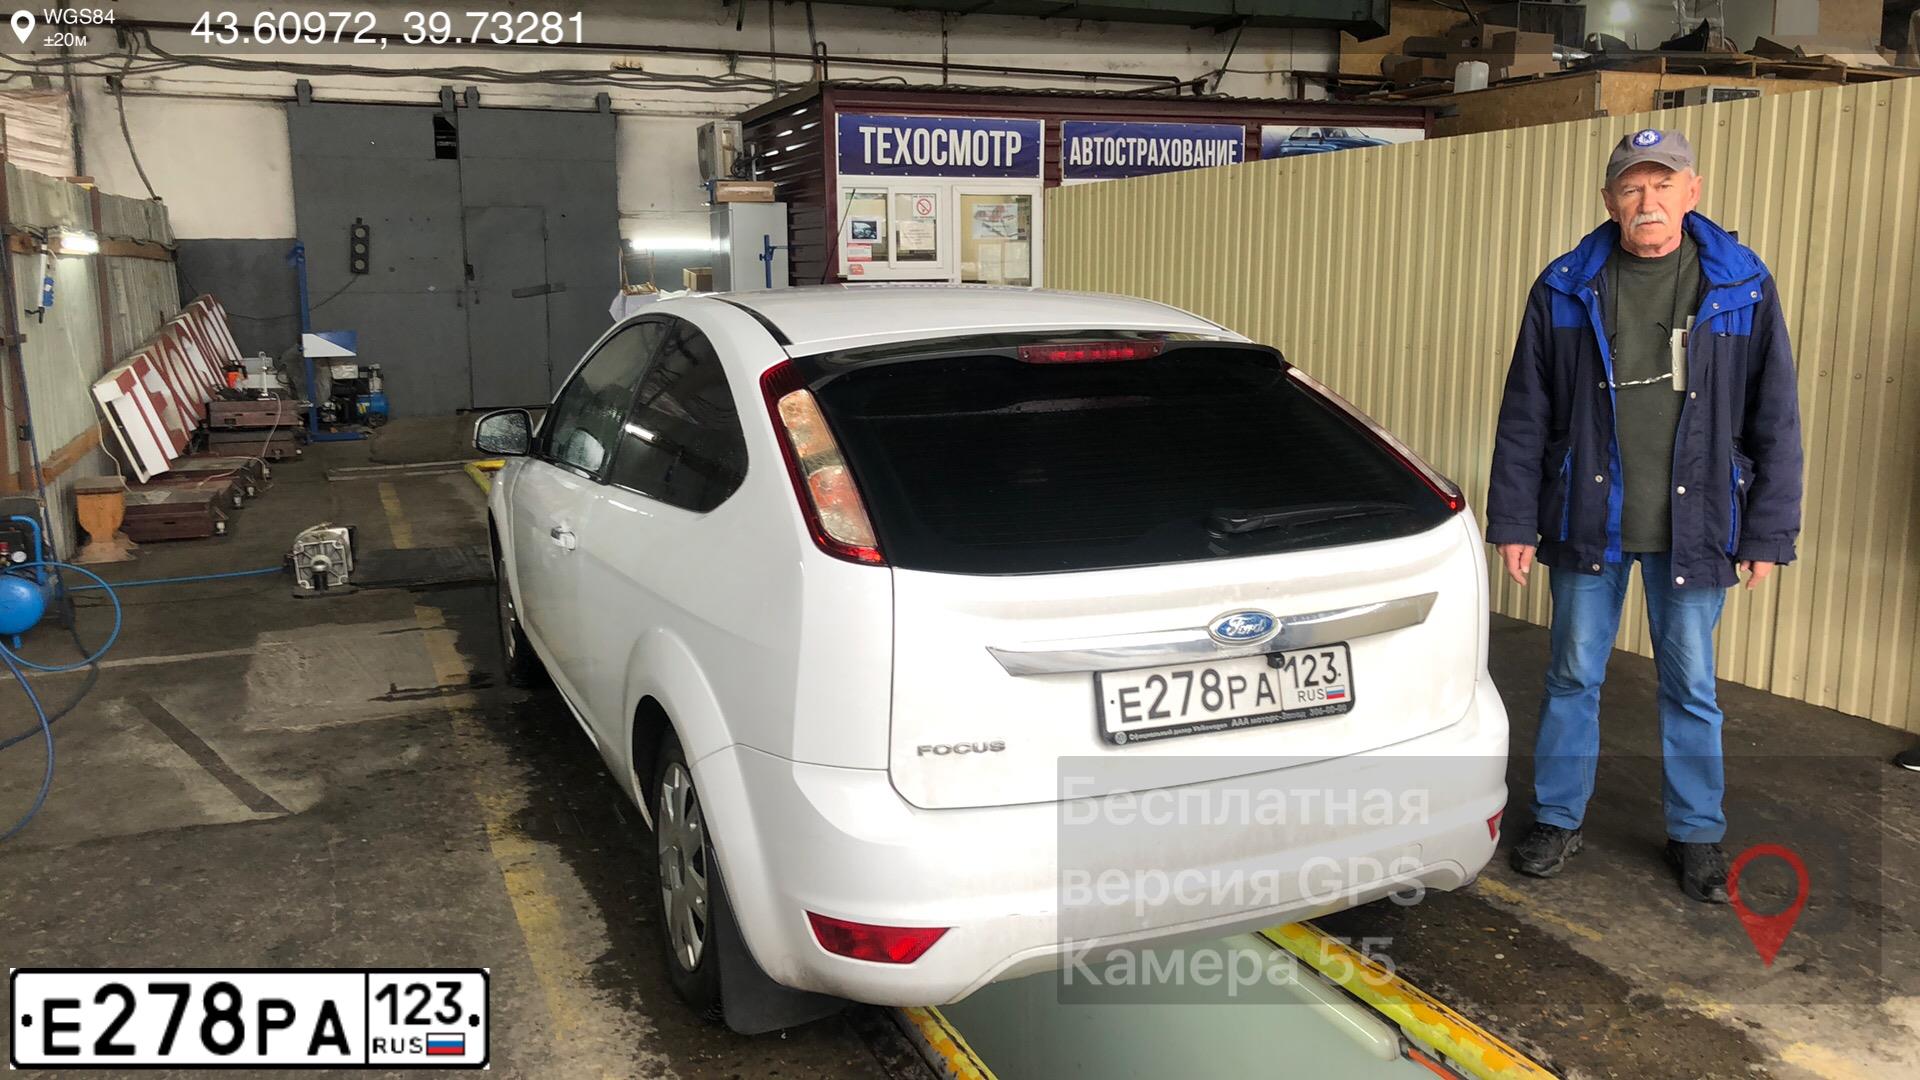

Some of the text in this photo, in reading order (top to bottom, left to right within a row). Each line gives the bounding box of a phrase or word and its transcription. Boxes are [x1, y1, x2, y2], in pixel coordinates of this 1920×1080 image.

[858, 126, 1023, 167] ТЕХОСМОТР
[1069, 136, 1238, 167] АВТОСТРАХОВАНИЕ
[1225, 618, 1265, 637] Ford
[1118, 651, 1337, 724] Е278РА 123
[1297, 688, 1325, 703] RUS
[917, 740, 1006, 757] FOCUS
